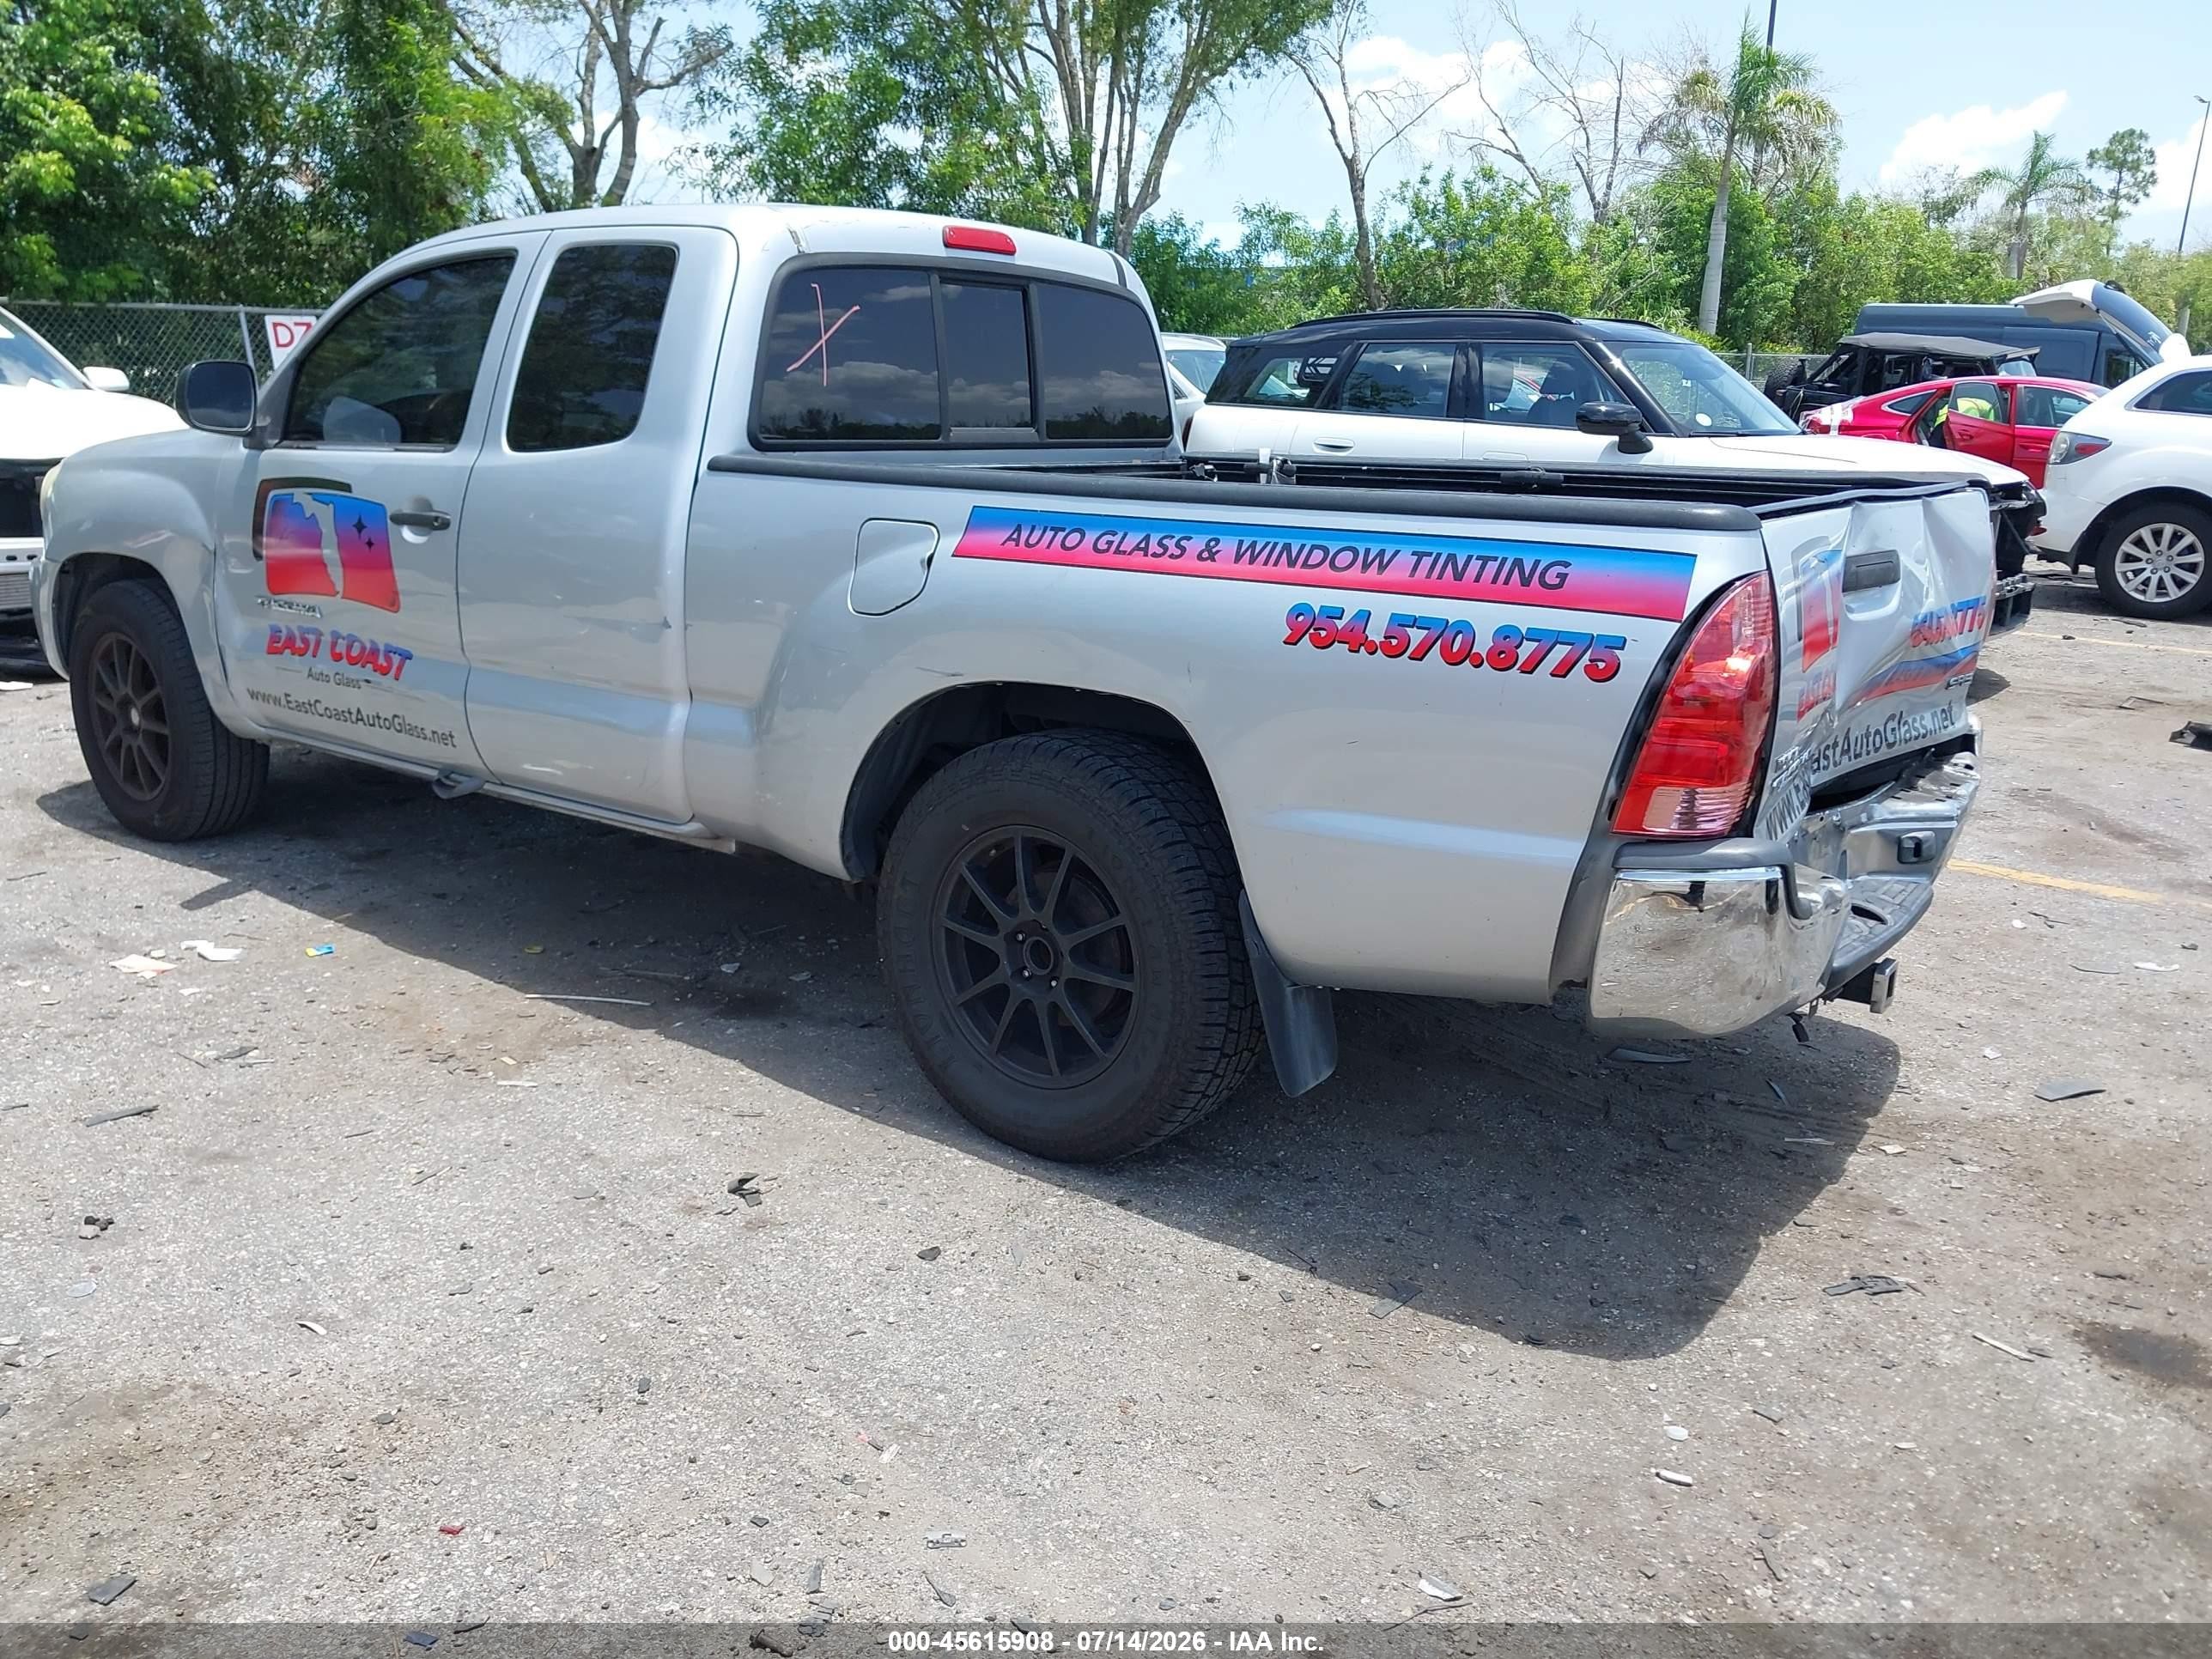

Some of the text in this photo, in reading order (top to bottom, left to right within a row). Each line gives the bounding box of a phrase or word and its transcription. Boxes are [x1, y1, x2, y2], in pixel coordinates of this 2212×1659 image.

[271, 322, 313, 348] D7
[1000, 523, 1572, 590] AUTO GLASS & WINDOW TINTING
[266, 624, 413, 681] EAST COAST
[1283, 602, 1626, 683] 954.570.8775
[307, 666, 362, 690] Auto Glass
[246, 688, 458, 748] www.EastCoastAutoGlass.net
